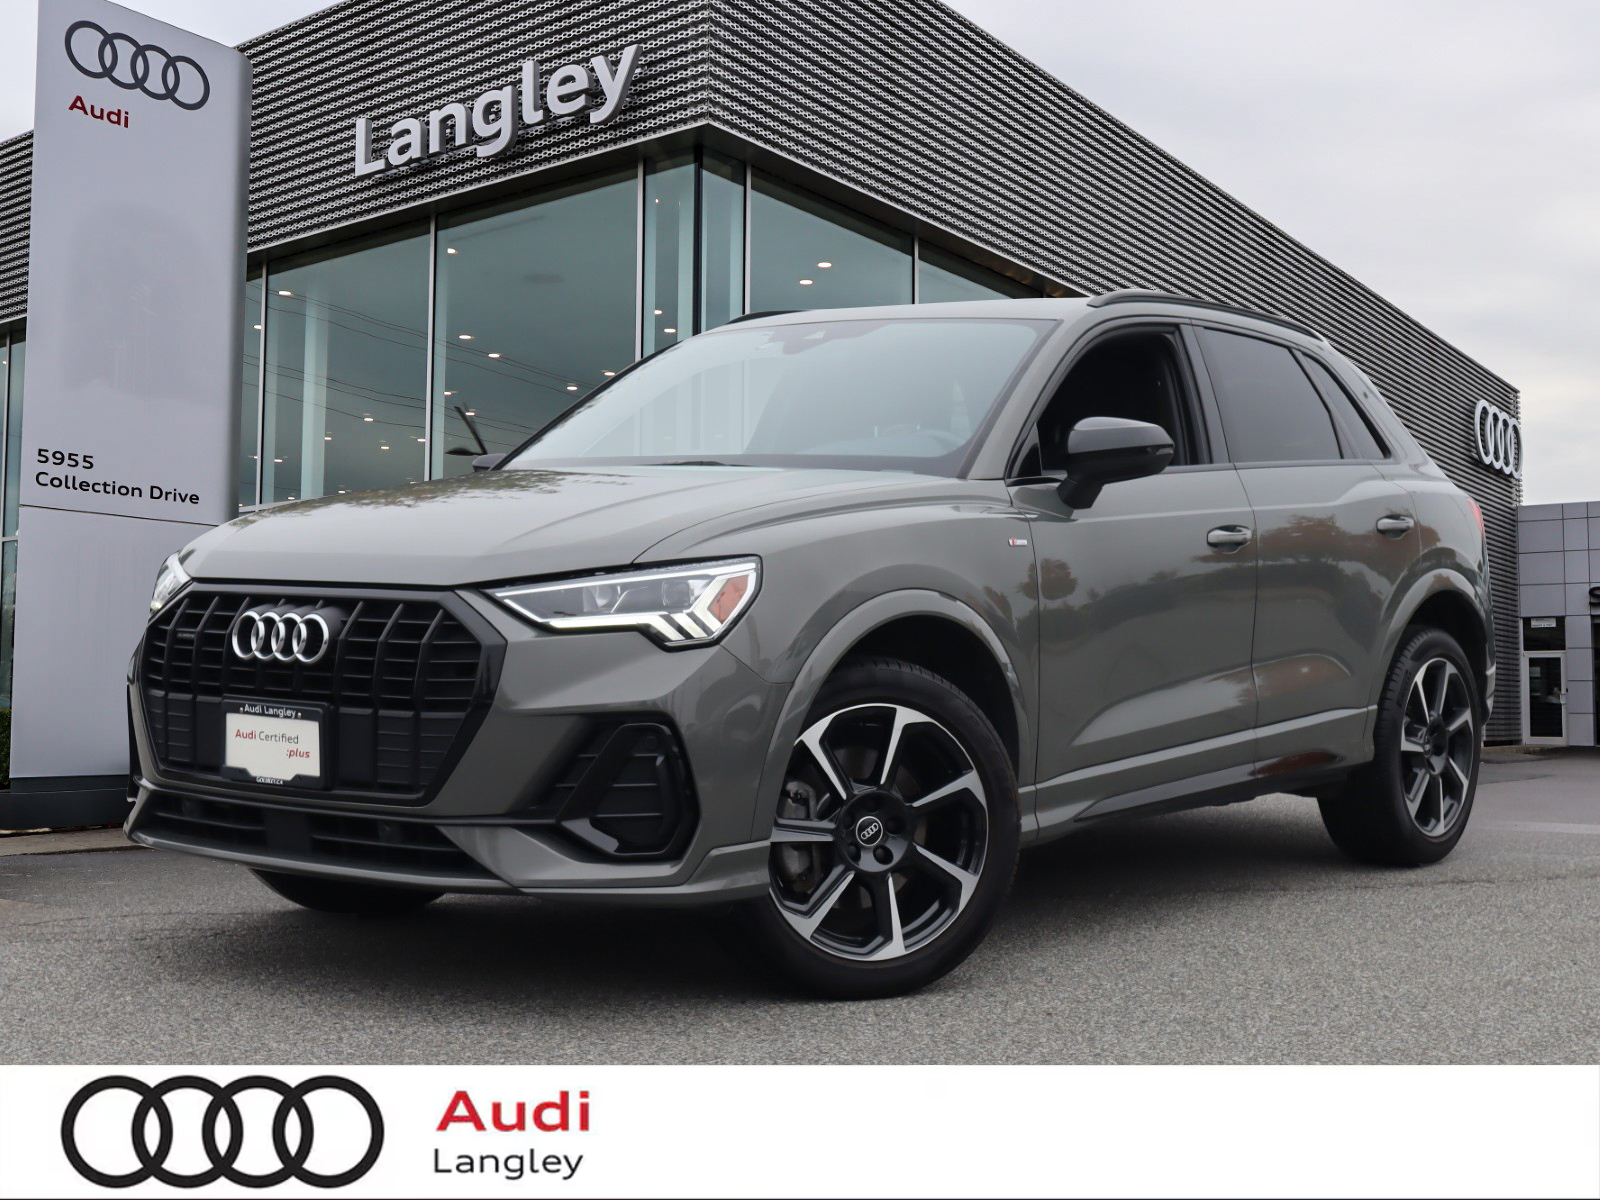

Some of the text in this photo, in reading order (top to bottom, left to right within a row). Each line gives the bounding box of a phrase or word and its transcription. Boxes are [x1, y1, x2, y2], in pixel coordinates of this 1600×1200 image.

[68, 94, 129, 128] Audi
[354, 44, 643, 177] Langley
[36, 448, 95, 470] 5955
[35, 471, 200, 504] Collection Drive
[244, 703, 297, 719] Audi Langley
[235, 728, 299, 745] Audi Certified
